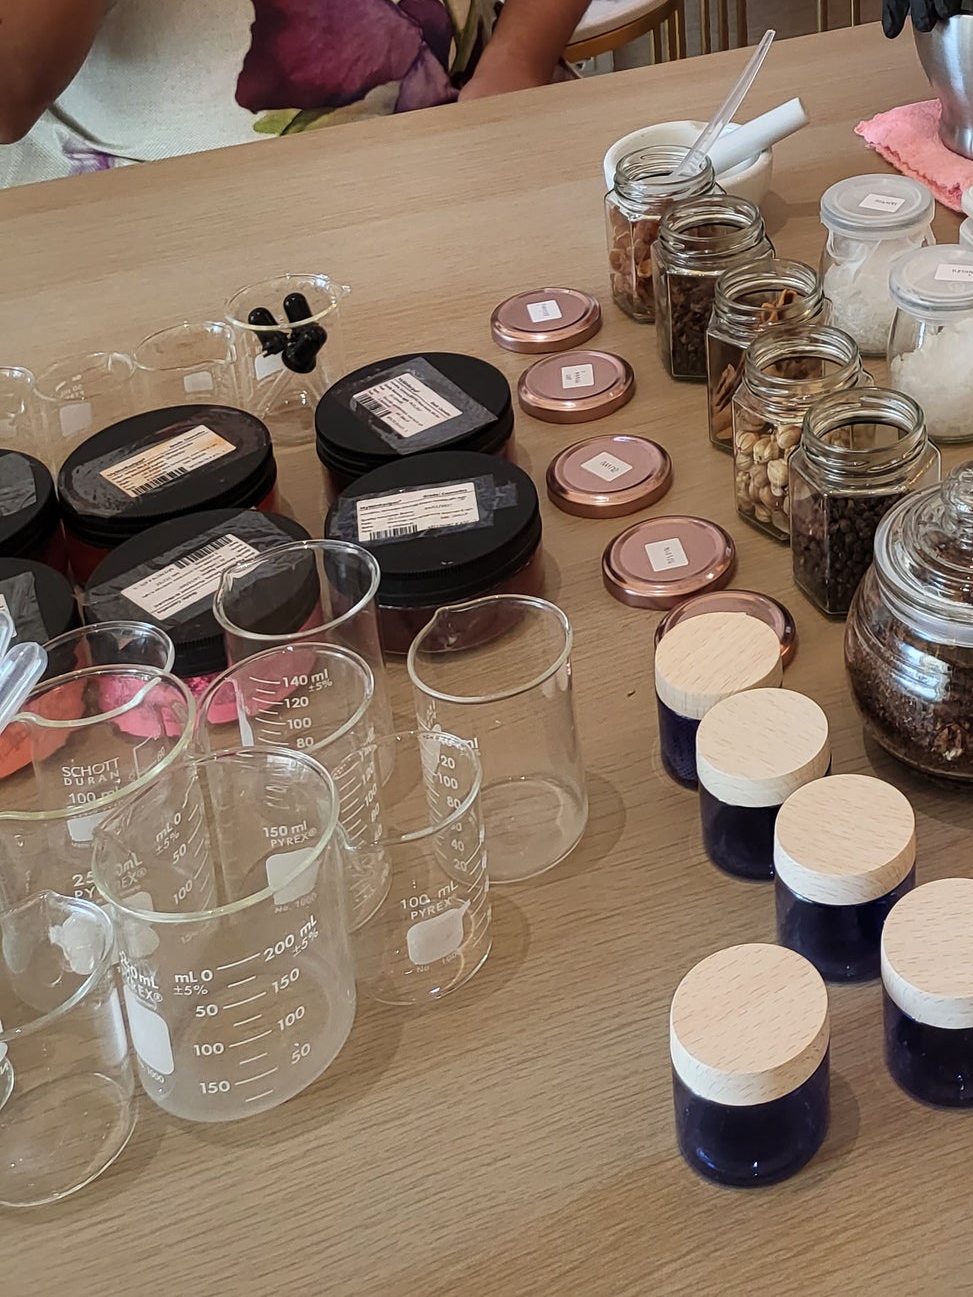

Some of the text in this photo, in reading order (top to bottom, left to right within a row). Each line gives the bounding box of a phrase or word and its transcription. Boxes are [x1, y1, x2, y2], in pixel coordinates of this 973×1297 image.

[282, 669, 329, 688] 140 ml
[308, 679, 333, 693] ±5%
[284, 696, 309, 709] 120
[287, 717, 312, 730] 100
[296, 736, 314, 749] 80
[62, 757, 120, 778] SCHOTT
[64, 770, 120, 786] DURAN
[437, 773, 459, 790] 100
[68, 792, 96, 805] 100
[155, 812, 182, 843] mL 0
[263, 820, 307, 838] 150 ml
[451, 839, 465, 852] 40
[173, 844, 187, 864] 50
[454, 859, 468, 872] 20
[173, 880, 193, 904] 100
[401, 880, 458, 909] 100 mL
[263, 914, 318, 963] 200 mL
[292, 928, 319, 958] ±5%
[174, 969, 213, 984] mL 0
[271, 967, 300, 994] 150
[173, 984, 208, 996] ±5%
[195, 1004, 218, 1018] 50
[277, 1005, 305, 1032] 100
[194, 1042, 224, 1056] 100
[291, 1043, 311, 1065] 50
[200, 1080, 230, 1094] 150
